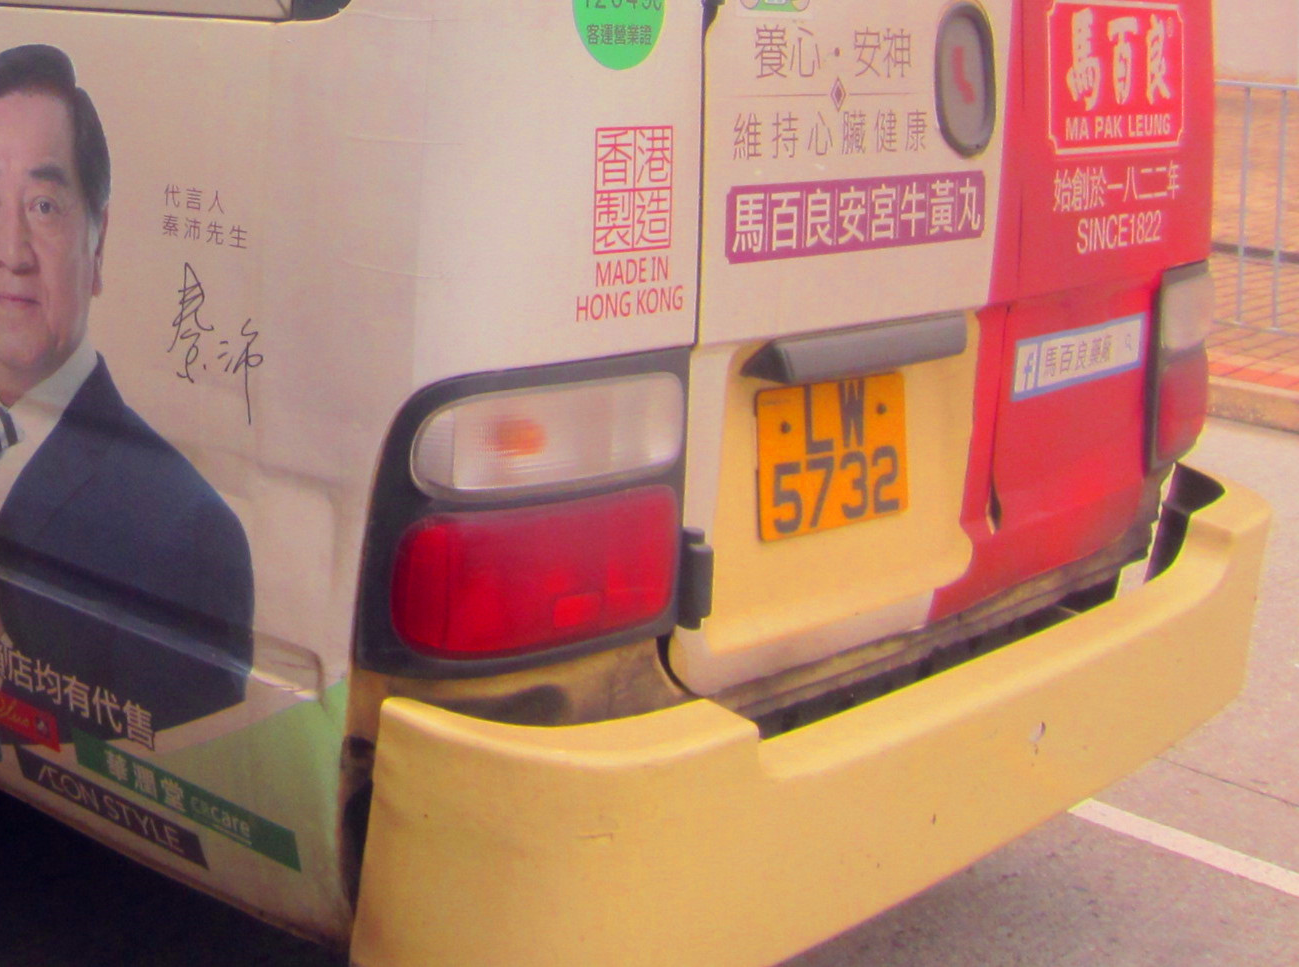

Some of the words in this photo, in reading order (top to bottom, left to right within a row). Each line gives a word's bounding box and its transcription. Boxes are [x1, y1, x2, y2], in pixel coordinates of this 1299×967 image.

[586, 24, 652, 46] 客運營業證
[1065, 118, 1089, 141] MA
[1095, 115, 1123, 139] PAK
[1128, 113, 1171, 137] LEUNG
[163, 184, 225, 214] 代言人
[732, 177, 980, 254] 馬百良安宮牛黃丸
[162, 214, 248, 249] 秦沛先生
[595, 257, 647, 287] MADE
[651, 256, 669, 282] IN
[575, 291, 631, 322] HONG
[636, 285, 684, 315] KONG
[803, 378, 866, 455] LW
[772, 445, 900, 534] 5732
[102, 793, 184, 853] STYLE
